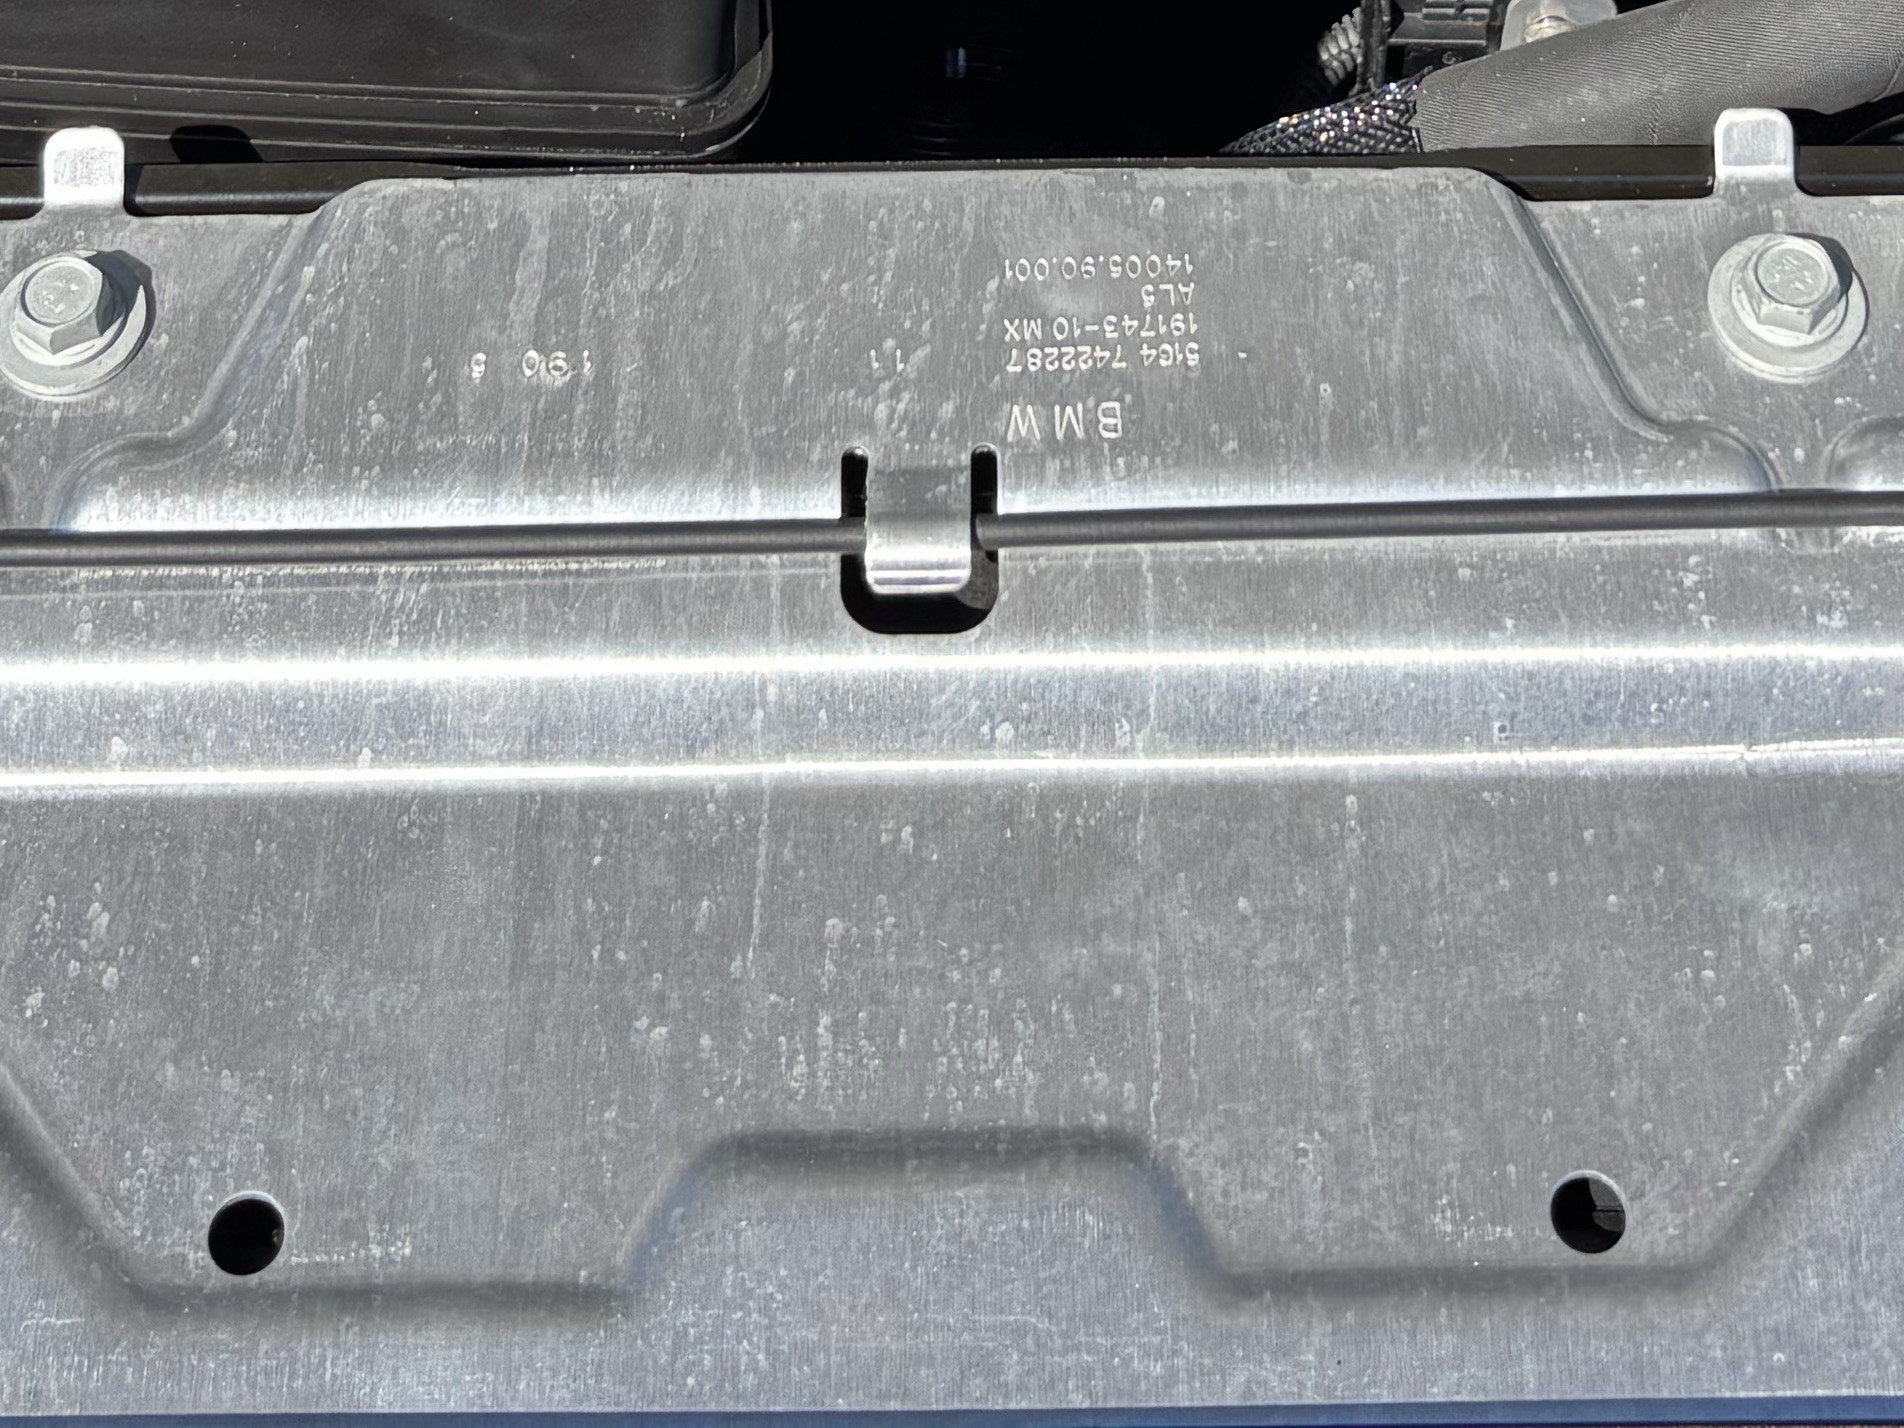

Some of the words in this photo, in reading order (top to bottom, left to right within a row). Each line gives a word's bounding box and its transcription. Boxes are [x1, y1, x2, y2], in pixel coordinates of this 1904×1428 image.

[1004, 253, 1194, 282] 14005.90.001
[1003, 317, 1043, 342] MX
[1052, 312, 1198, 341] 191743-10
[1005, 344, 1127, 373] 7422287
